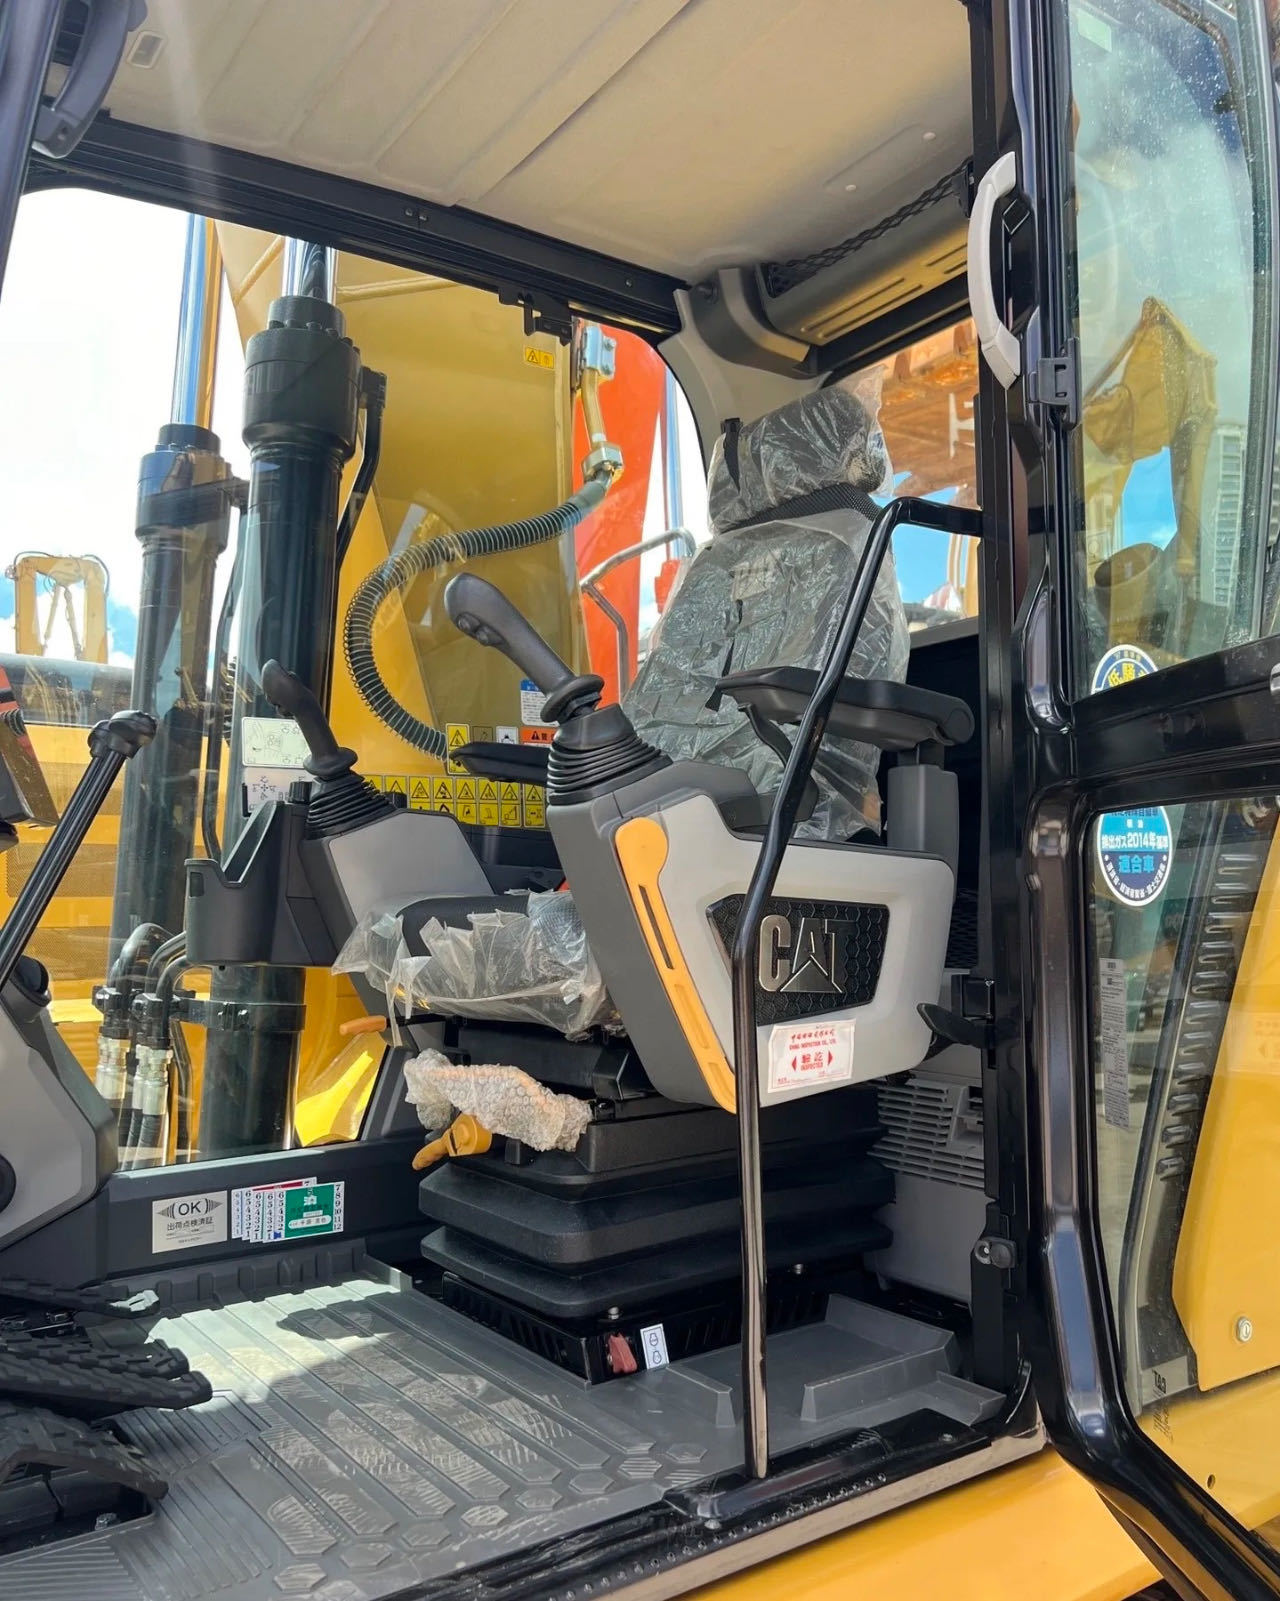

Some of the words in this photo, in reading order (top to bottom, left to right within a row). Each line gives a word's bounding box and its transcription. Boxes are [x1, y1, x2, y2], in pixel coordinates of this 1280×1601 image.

[1118, 854, 1155, 874] 適合車
[759, 915, 857, 993] CAT
[178, 1201, 202, 1216] OK
